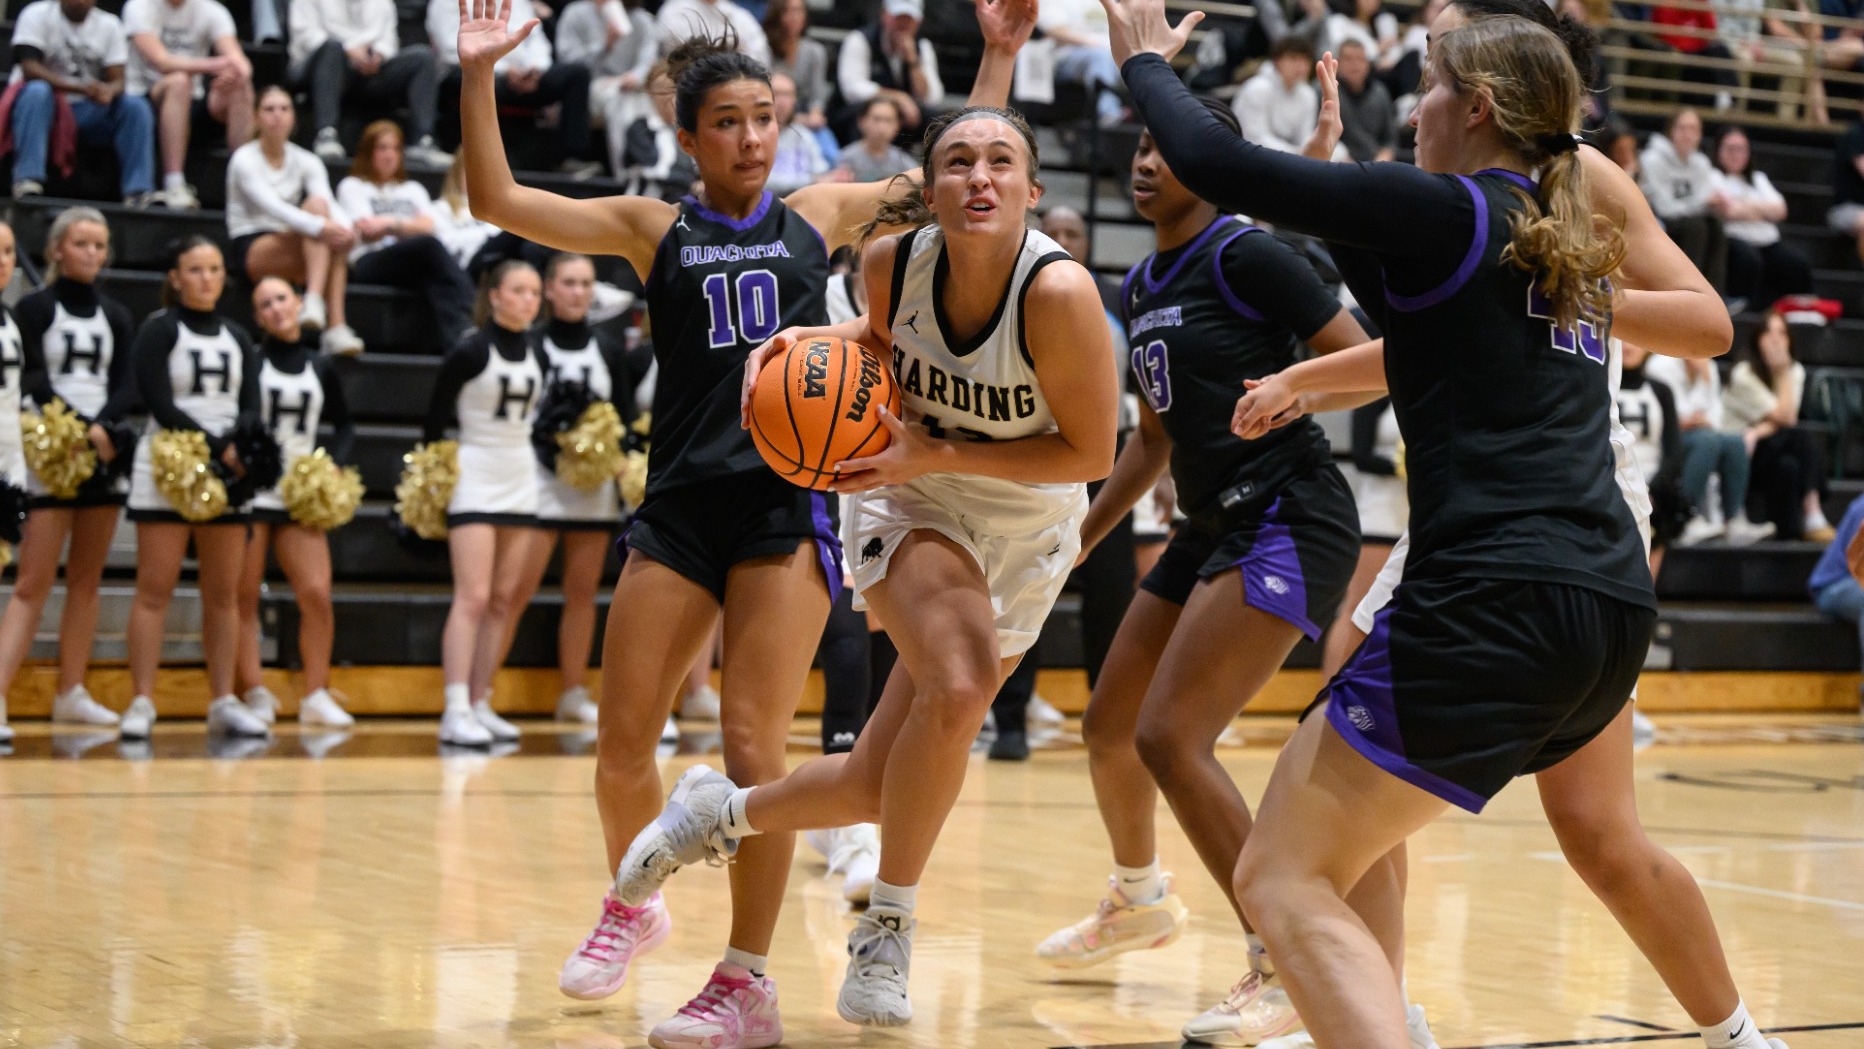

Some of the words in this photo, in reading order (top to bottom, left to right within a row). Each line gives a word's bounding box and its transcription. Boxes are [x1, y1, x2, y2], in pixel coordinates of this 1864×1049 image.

[681, 240, 790, 267] OUACHITA
[702, 269, 780, 349] 10
[60, 331, 101, 374] H
[190, 350, 230, 393] H
[803, 341, 831, 399] NCAA
[1131, 339, 1172, 414] 13
[495, 375, 536, 419] H
[845, 344, 882, 423] Wilson
[893, 343, 1036, 422] HARDING
[267, 388, 312, 434] H
